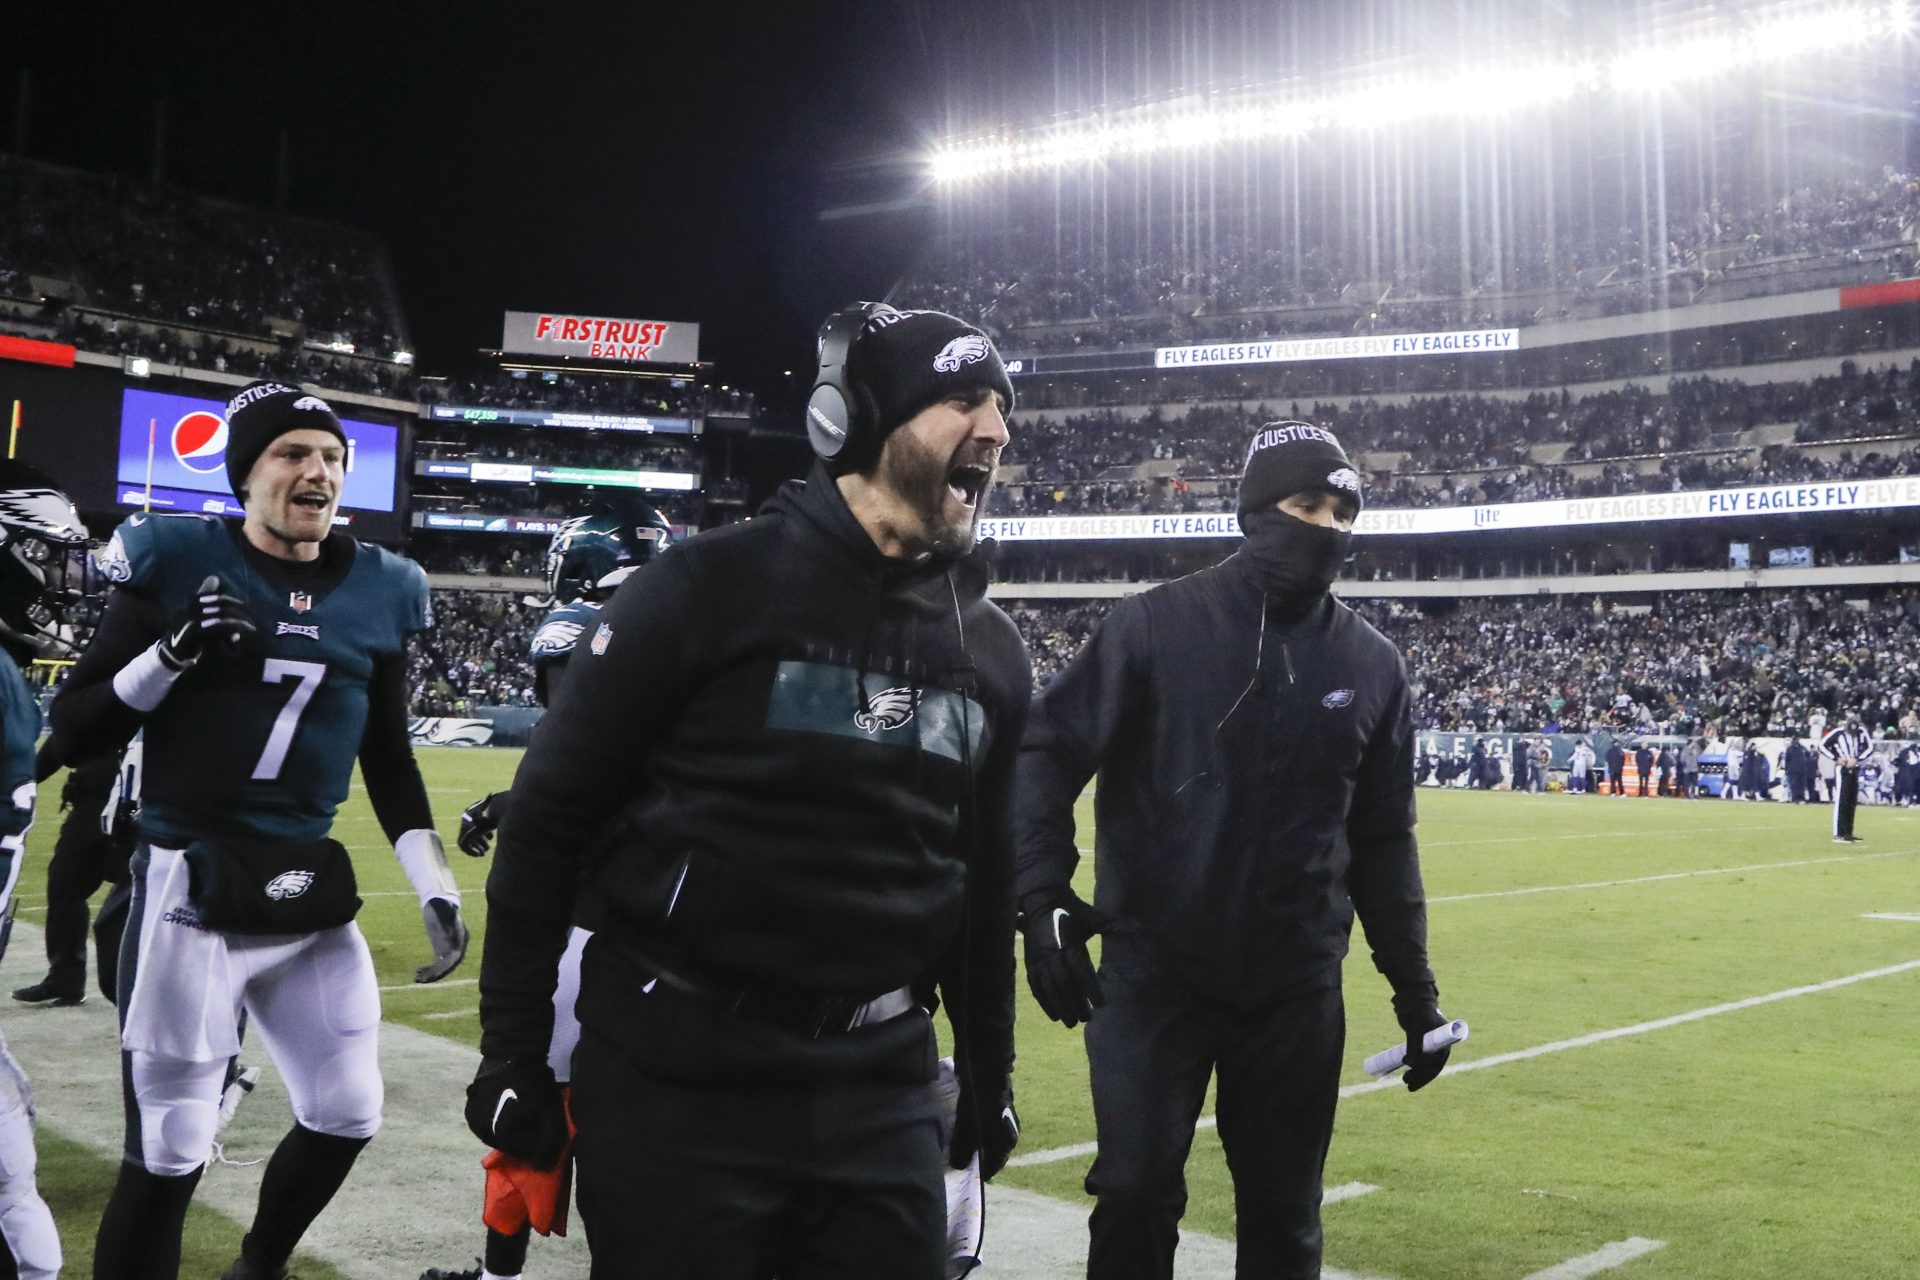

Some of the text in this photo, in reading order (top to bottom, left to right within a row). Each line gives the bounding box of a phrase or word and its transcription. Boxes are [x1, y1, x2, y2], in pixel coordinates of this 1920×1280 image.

[590, 343, 651, 361] BANK
[1164, 332, 1511, 364] FLY EAGLES FLY FLY EAGLES FLY FLY EAGLES FLY
[1259, 426, 1323, 449] JUSTICE
[1566, 495, 1702, 520] FLY EAGLES FLY
[1709, 493, 1740, 512] FLY
[1746, 488, 1819, 510] EAGLES
[1825, 485, 1859, 506] FLY
[1865, 482, 1900, 503] FLY
[1001, 521, 1025, 537] FLY
[1029, 520, 1055, 536] FLY
[1060, 518, 1118, 535] EAGLES
[1122, 518, 1149, 535] FLY
[1153, 518, 1179, 534] FLY
[1184, 517, 1241, 533] EAGLE
[1386, 513, 1416, 530] FLY
[1474, 508, 1500, 528] Lite
[251, 657, 327, 780] 7
